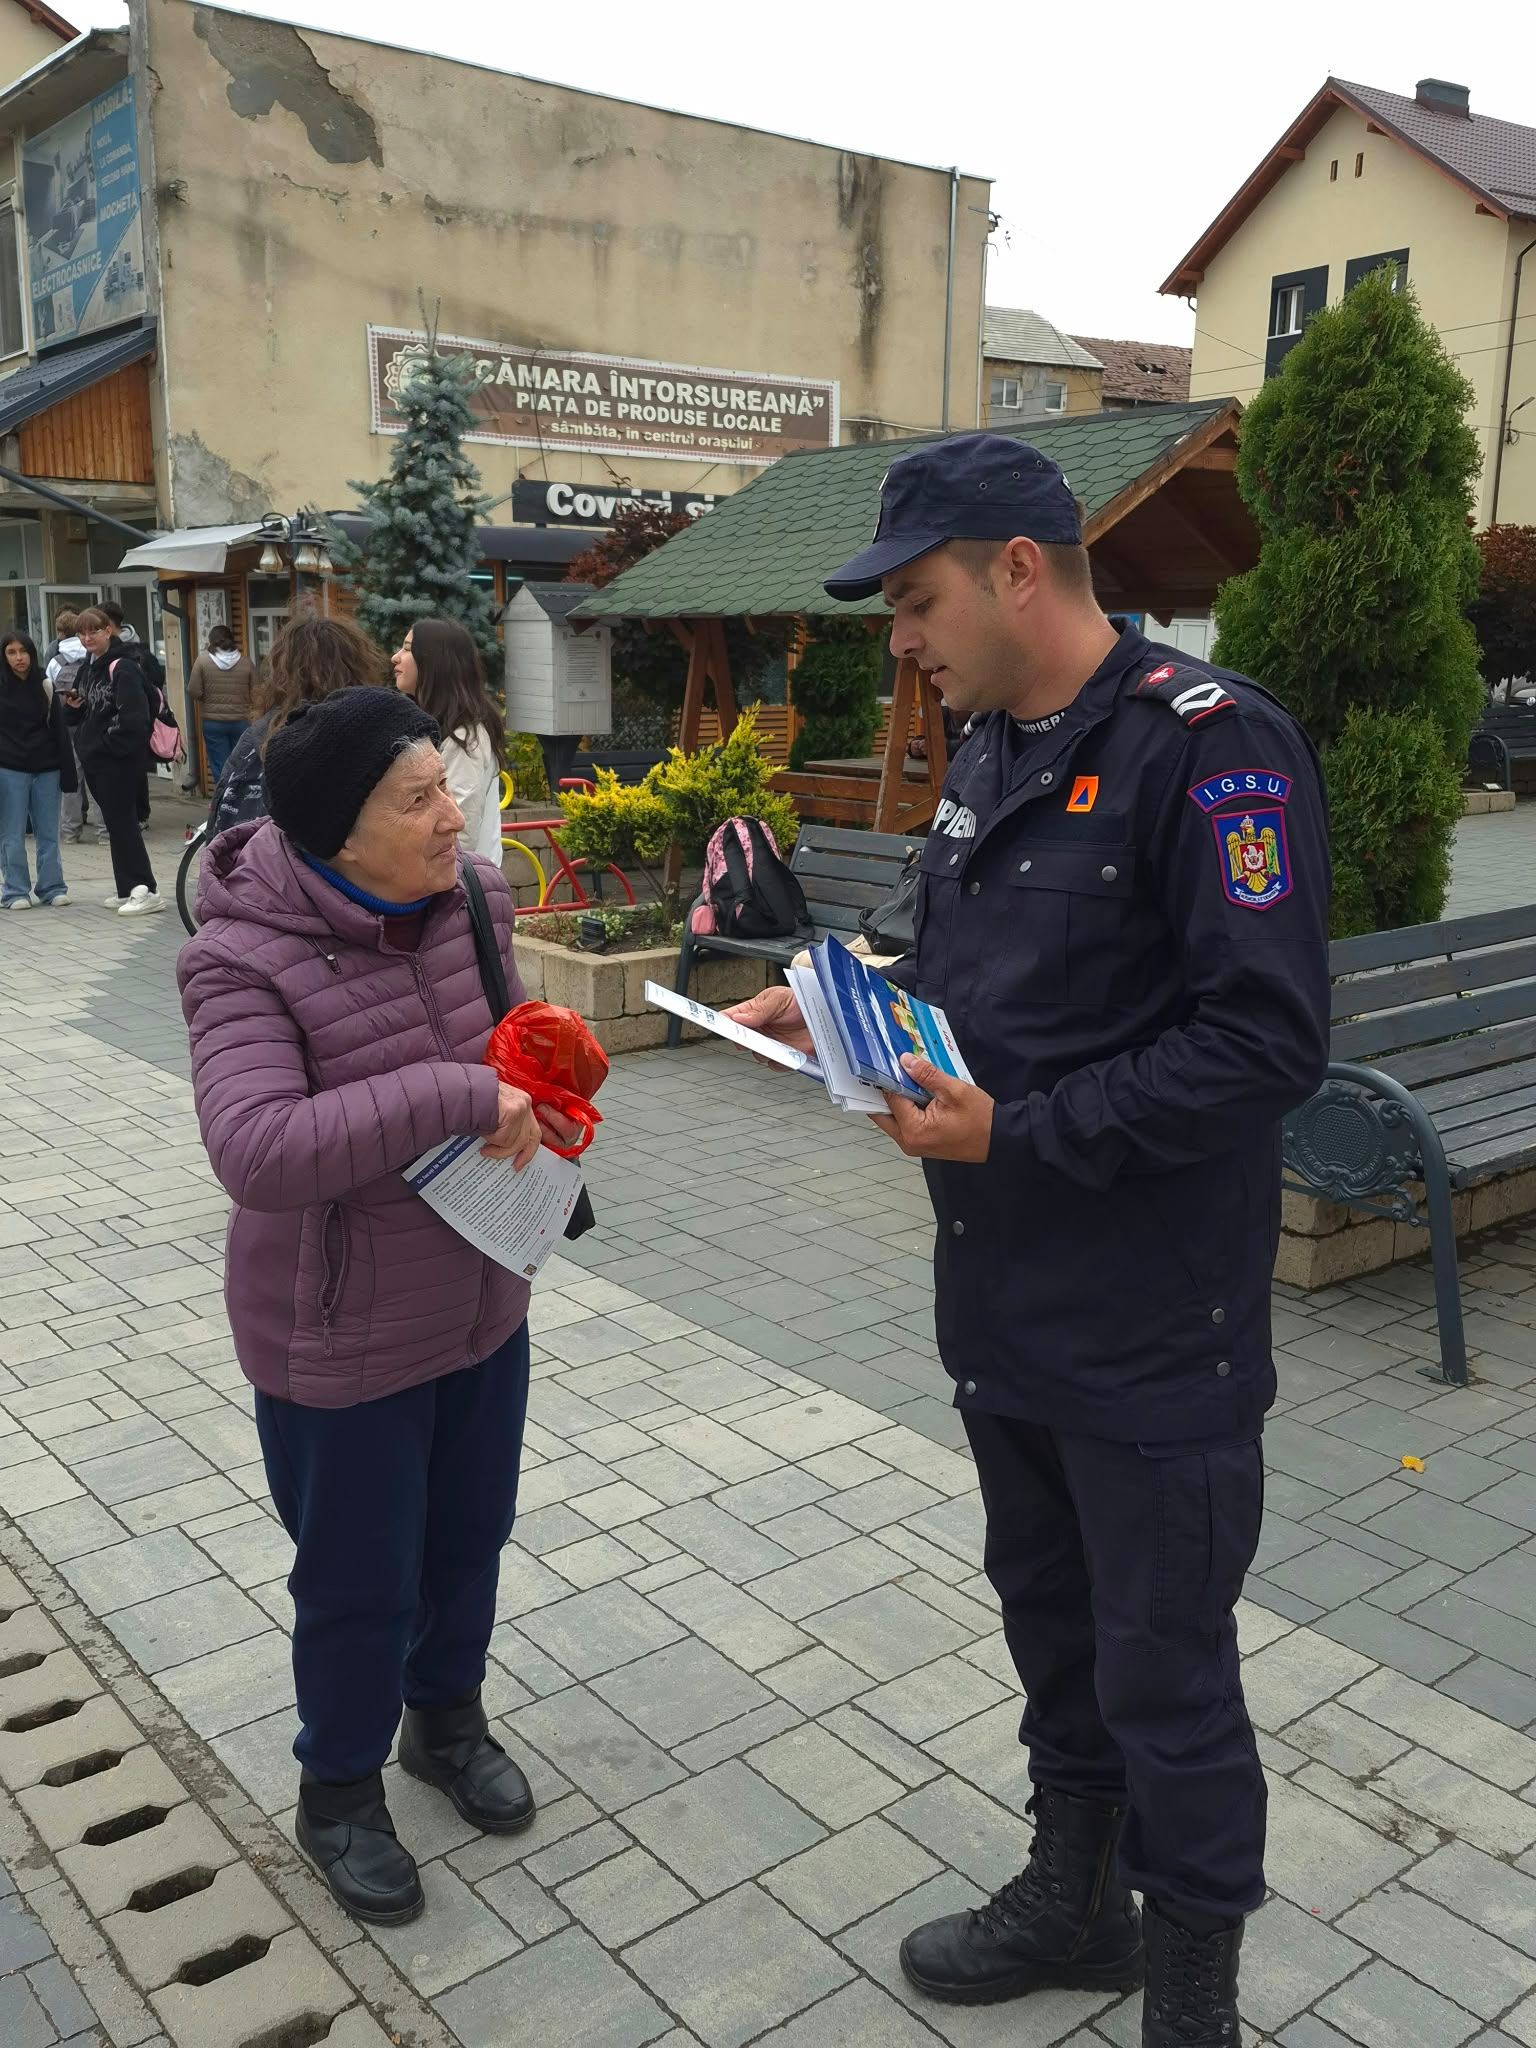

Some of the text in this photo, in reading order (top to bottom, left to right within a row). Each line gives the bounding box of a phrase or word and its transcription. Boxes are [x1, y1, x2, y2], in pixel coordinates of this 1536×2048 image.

[32, 251, 102, 299] ELECTROCASNICE
[475, 356, 601, 396] CĂMARA
[585, 399, 612, 418] DE
[617, 402, 708, 427] PRODUSE
[713, 412, 782, 433] LOCALE
[626, 427, 640, 441] în
[643, 430, 695, 445] centrul
[1203, 774, 1283, 801] I.G.S.U.
